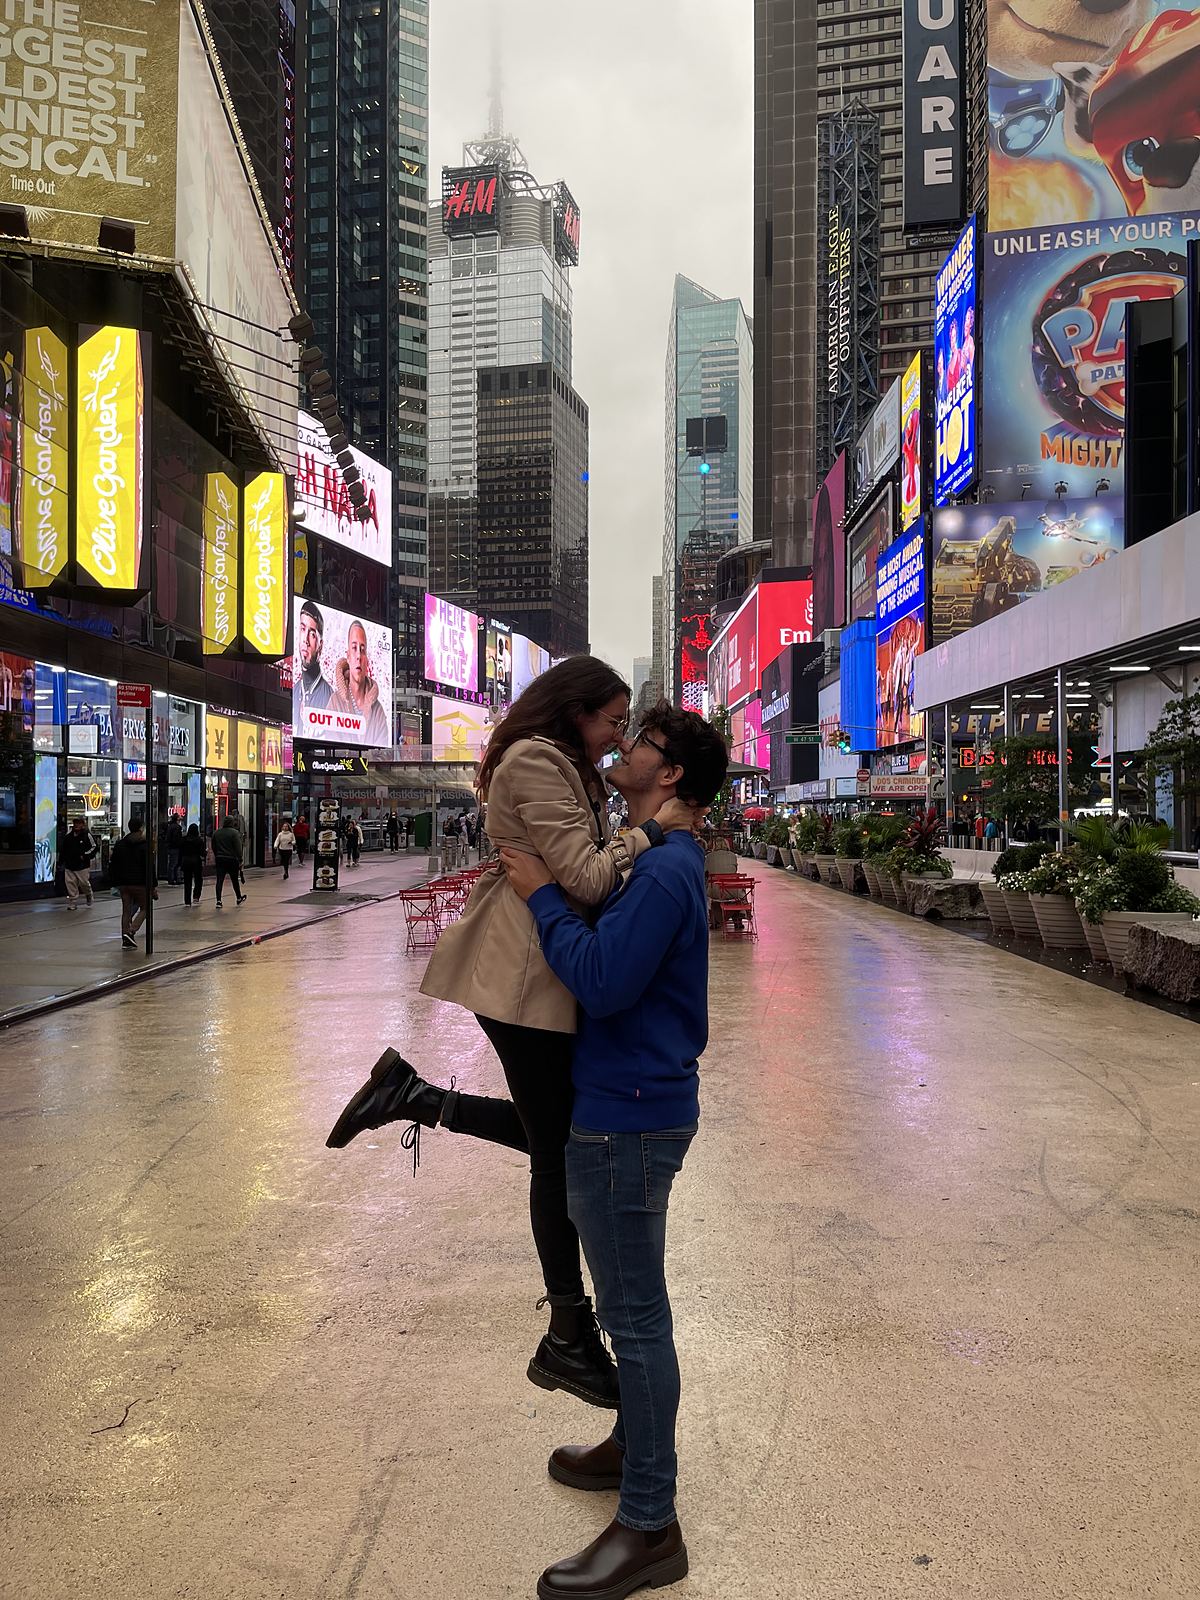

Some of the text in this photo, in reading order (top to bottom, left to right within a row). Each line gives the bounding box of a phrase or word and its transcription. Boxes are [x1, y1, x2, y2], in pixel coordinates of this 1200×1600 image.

[10, 174, 56, 196] Time Out
[445, 177, 497, 219] H&M
[993, 228, 1100, 256] UNLEASH
[1109, 219, 1173, 243] YOUR
[936, 225, 974, 302] WINNER
[828, 205, 839, 394] AMERICAN EAGLE
[839, 228, 850, 363] OUTFITTERS
[936, 388, 973, 481] HOT
[1040, 431, 1122, 469] MIGHT
[91, 390, 126, 576] Olive Garden
[253, 516, 278, 646] Olive Garden
[877, 574, 898, 604] WINNING
[898, 552, 924, 587] MUSICAL
[878, 564, 887, 586] THE
[887, 551, 901, 579] MOST
[902, 534, 924, 566] AWARD-
[440, 599, 467, 633] HERE
[879, 600, 887, 619] OF
[887, 592, 897, 613] THE
[896, 575, 920, 607] SEASON!
[441, 624, 466, 659] LIES
[440, 651, 468, 684] LOVE
[308, 712, 362, 730] OUT NOW
[872, 784, 886, 792] WE
[888, 784, 905, 792] ARE
[876, 777, 927, 786] DOS CAMINOS
